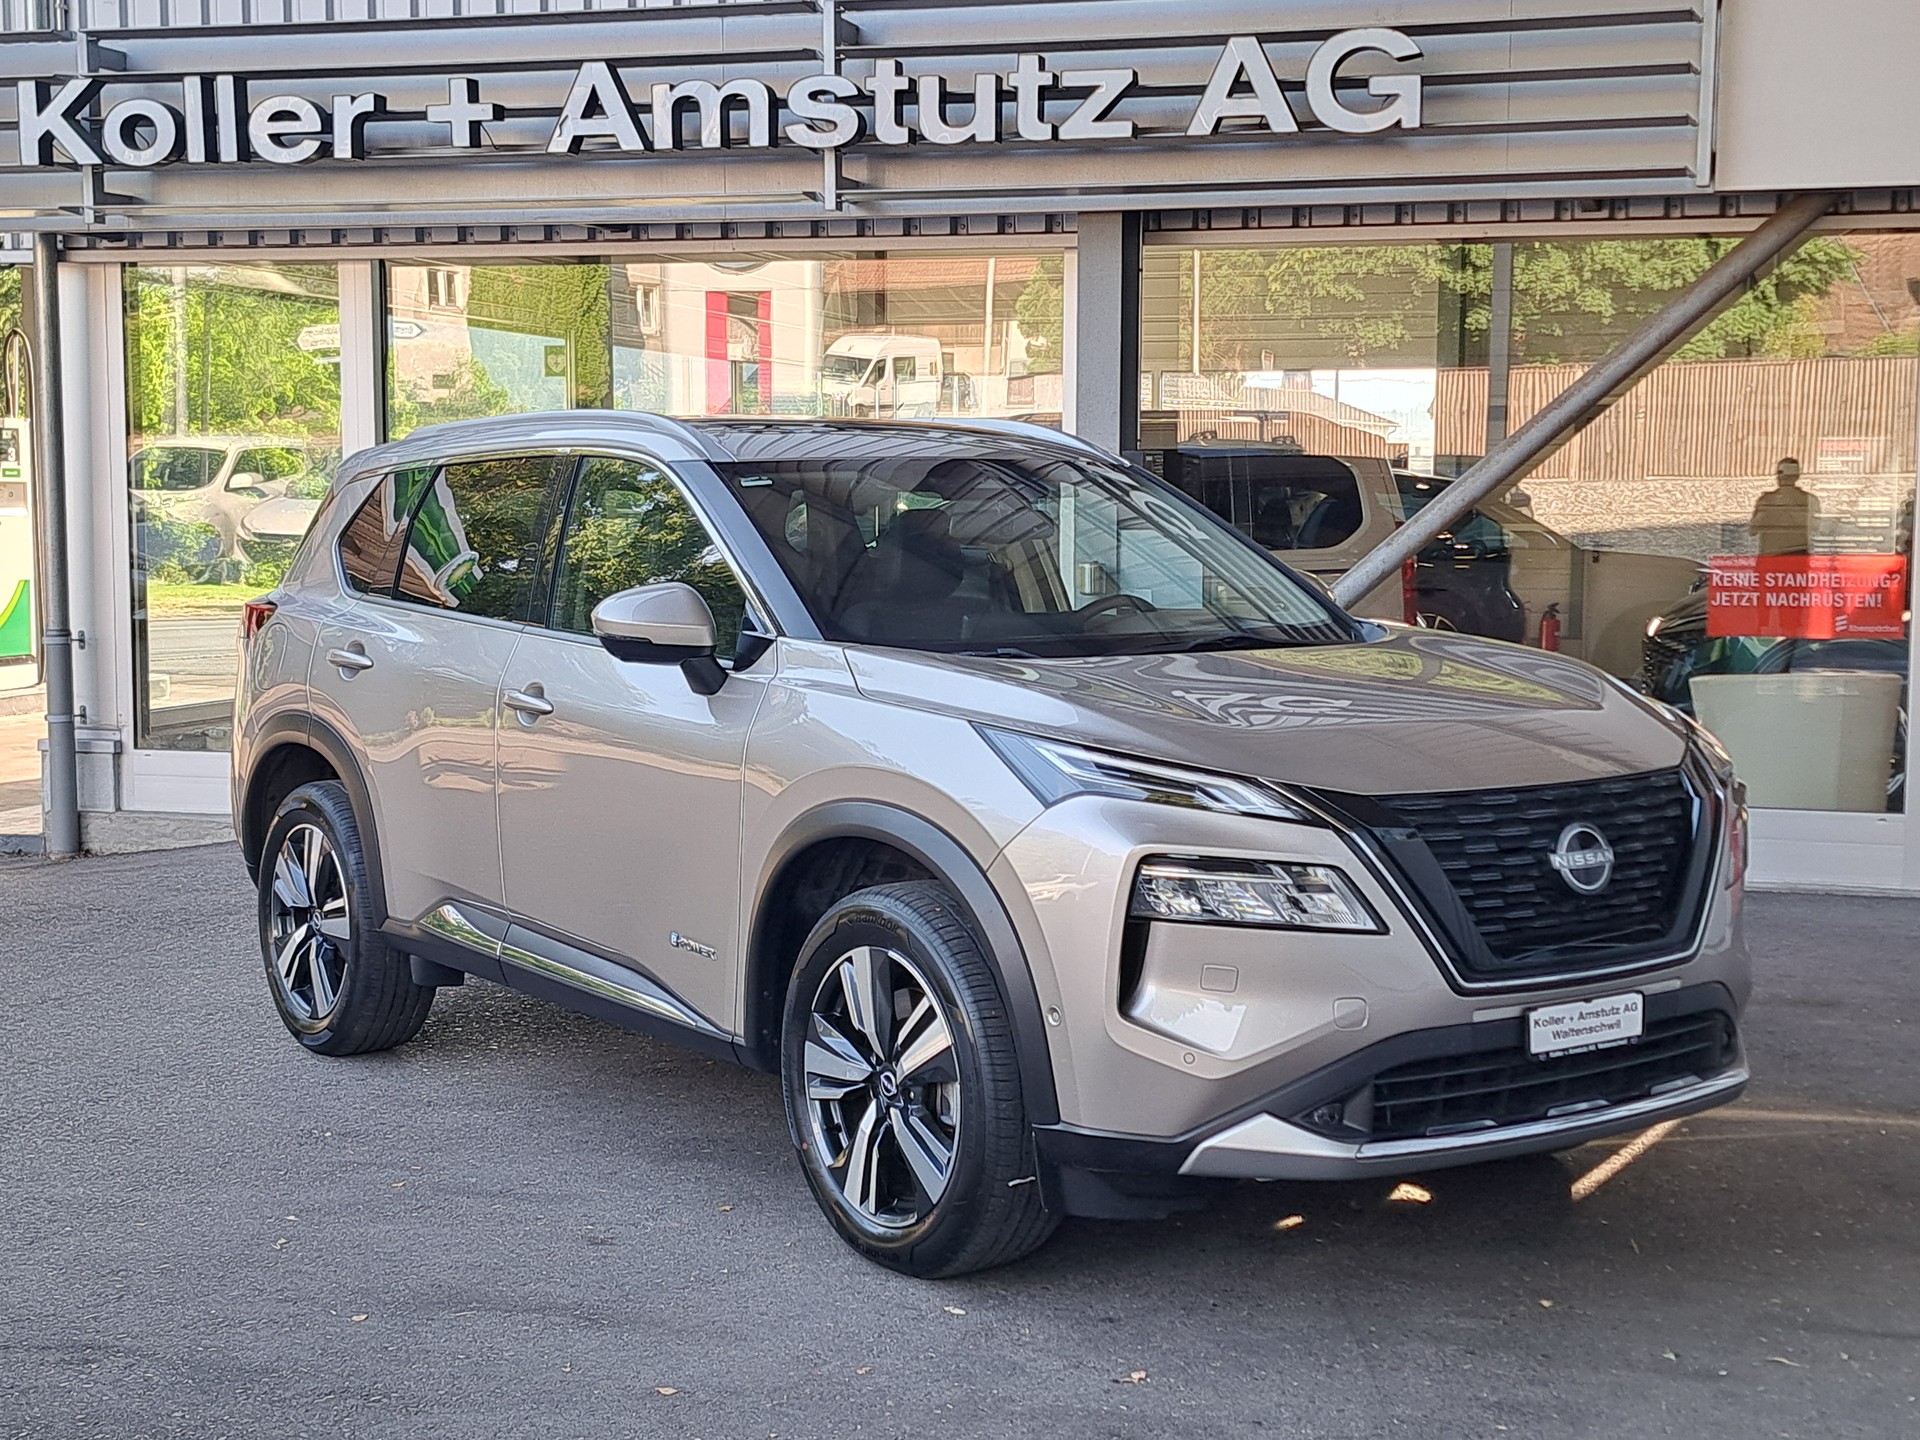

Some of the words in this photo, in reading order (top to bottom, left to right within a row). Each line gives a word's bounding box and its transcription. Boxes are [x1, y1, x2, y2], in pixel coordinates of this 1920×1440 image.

[17, 74, 382, 167] Koller
[427, 77, 500, 148] +
[546, 53, 1140, 154] Amstutz
[1186, 27, 1425, 136] AG
[1711, 572, 1760, 588] KEINE
[1764, 572, 1901, 589] STANDHEIZUNG?
[1711, 592, 1760, 607] JETZT
[1765, 589, 1883, 609] NACHRÜSTEN!
[1554, 851, 1613, 868] NISSAN
[1533, 1015, 1566, 1029] Koller
[1577, 1006, 1621, 1021] Amstutz
[1623, 1002, 1638, 1013] AG
